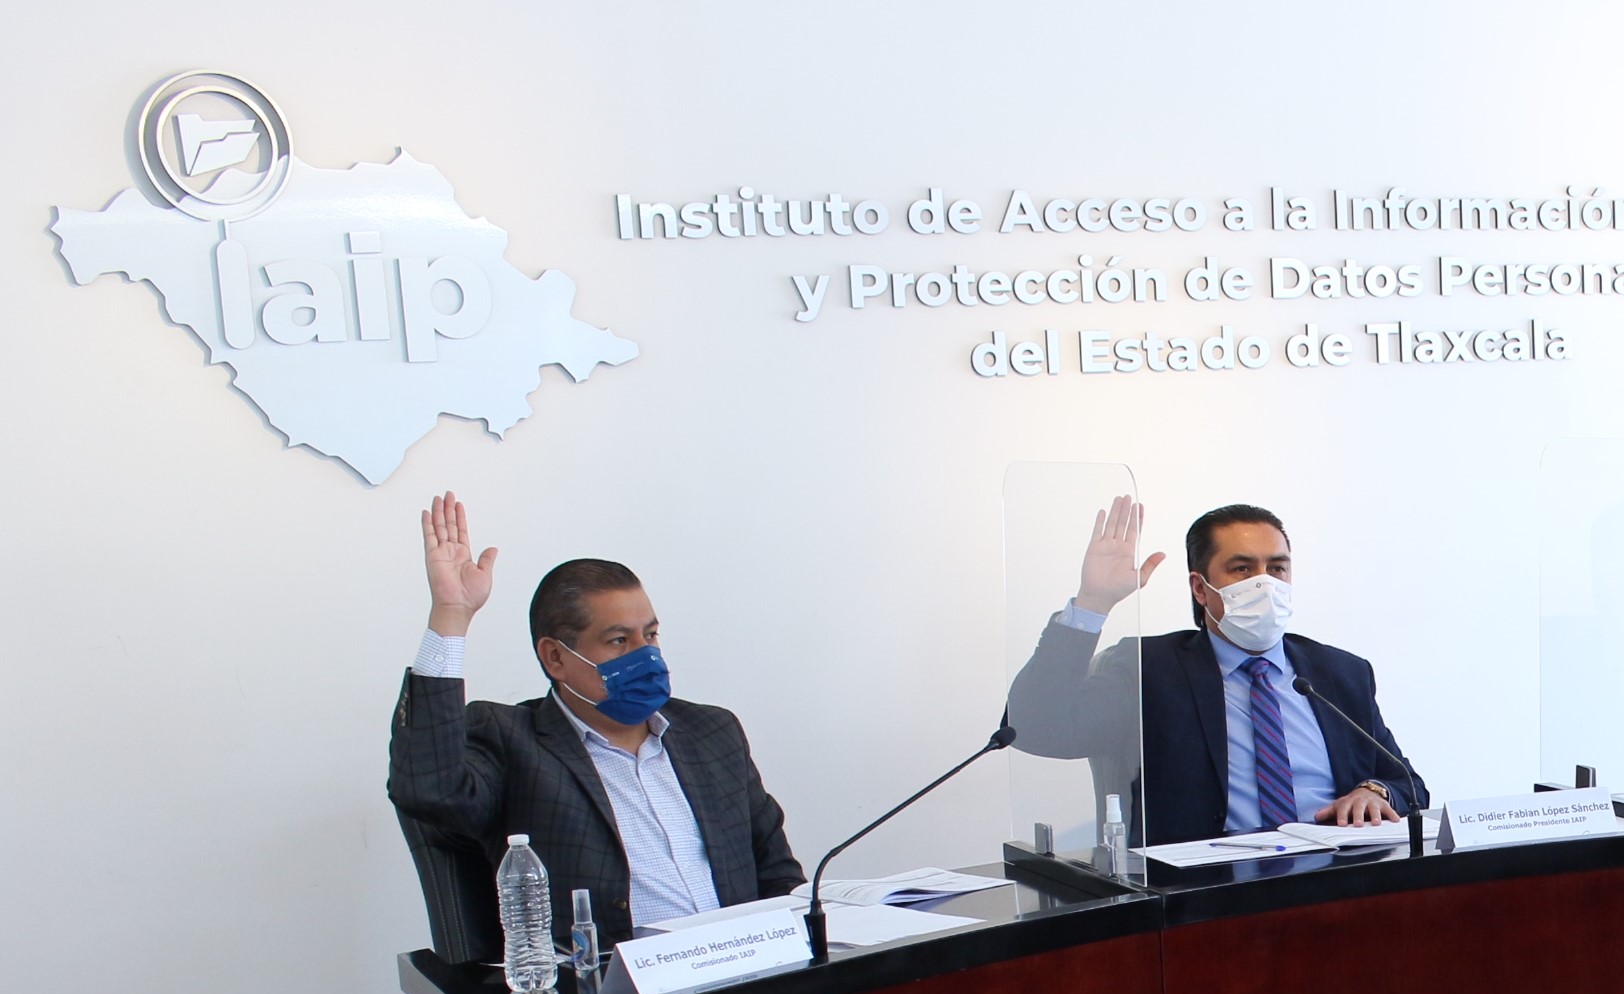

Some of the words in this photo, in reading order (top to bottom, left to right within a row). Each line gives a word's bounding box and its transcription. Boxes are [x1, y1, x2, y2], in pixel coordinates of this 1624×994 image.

[615, 186, 890, 239] Instituto
[907, 187, 983, 234] de
[999, 189, 1207, 233] Acceso
[1223, 198, 1254, 231] a
[1270, 186, 1317, 231] la
[791, 274, 830, 322] y
[848, 254, 1168, 308] Protección
[1184, 256, 1254, 301] de
[1269, 257, 1424, 299] Datos
[971, 329, 1060, 377] del
[1078, 325, 1271, 374] Estado
[1285, 323, 1353, 368] de
[1365, 319, 1573, 365] Tlaxcala
[1459, 814, 1476, 824] Lic.
[1478, 811, 1507, 822] Didier
[1509, 807, 1541, 819] Fabian
[1542, 805, 1570, 817] López
[1571, 802, 1610, 813] Sánchez
[1488, 822, 1533, 832] Comisionado
[1533, 818, 1571, 827] Presidente
[1571, 816, 1587, 824] IAIP
[634, 957, 657, 970] Lic.
[656, 947, 709, 964] Fernando
[709, 934, 765, 953] Hernández
[767, 925, 797, 941] López
[691, 954, 739, 970] Comisionado
[740, 949, 757, 960] IAIP
